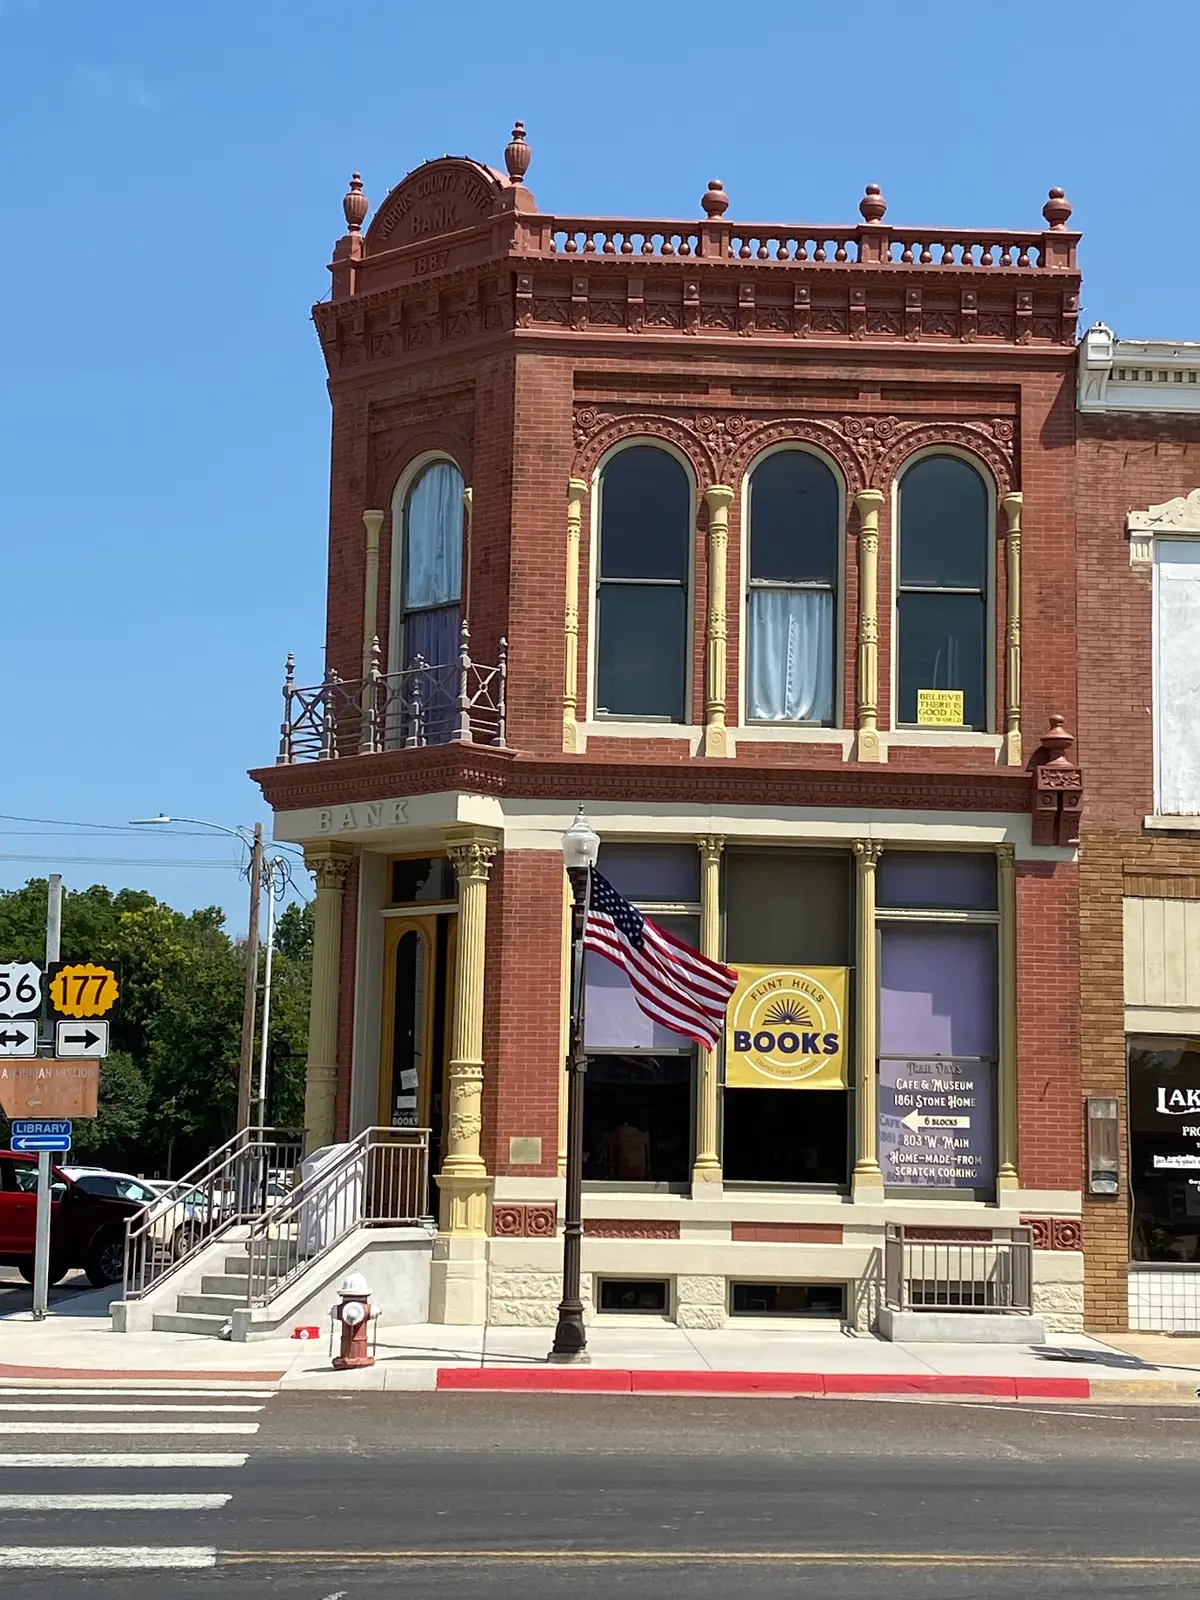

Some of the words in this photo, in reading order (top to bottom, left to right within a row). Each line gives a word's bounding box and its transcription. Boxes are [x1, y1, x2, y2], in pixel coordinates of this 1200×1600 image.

[379, 192, 412, 240] MORRIS
[416, 173, 459, 198] COUNTY
[461, 178, 492, 213] STATE
[412, 251, 450, 276] 1887
[919, 693, 961, 701] BELIEVE
[919, 708, 947, 716] GOOD
[316, 801, 409, 834] BANK
[0, 973, 36, 1003] 56
[61, 975, 108, 1006] 177
[750, 978, 784, 1002] FLINT
[791, 979, 825, 1003] HILLS
[734, 1031, 839, 1055] BOOKS
[935, 1062, 962, 1075] DAYS
[896, 1078, 919, 1090] CAFE
[920, 1080, 929, 1090] &
[931, 1079, 974, 1092] MUSEUM
[894, 1094, 913, 1106] 1861
[916, 1095, 946, 1107] STONE
[947, 1096, 976, 1109] HOME
[924, 1116, 930, 1125] 6
[16, 1124, 67, 1133] LIBRARY
[903, 1135, 922, 1146] 803
[942, 1136, 970, 1150] MAIN
[895, 1167, 935, 1176] SCRATCH
[937, 1168, 977, 1178] COOKING
